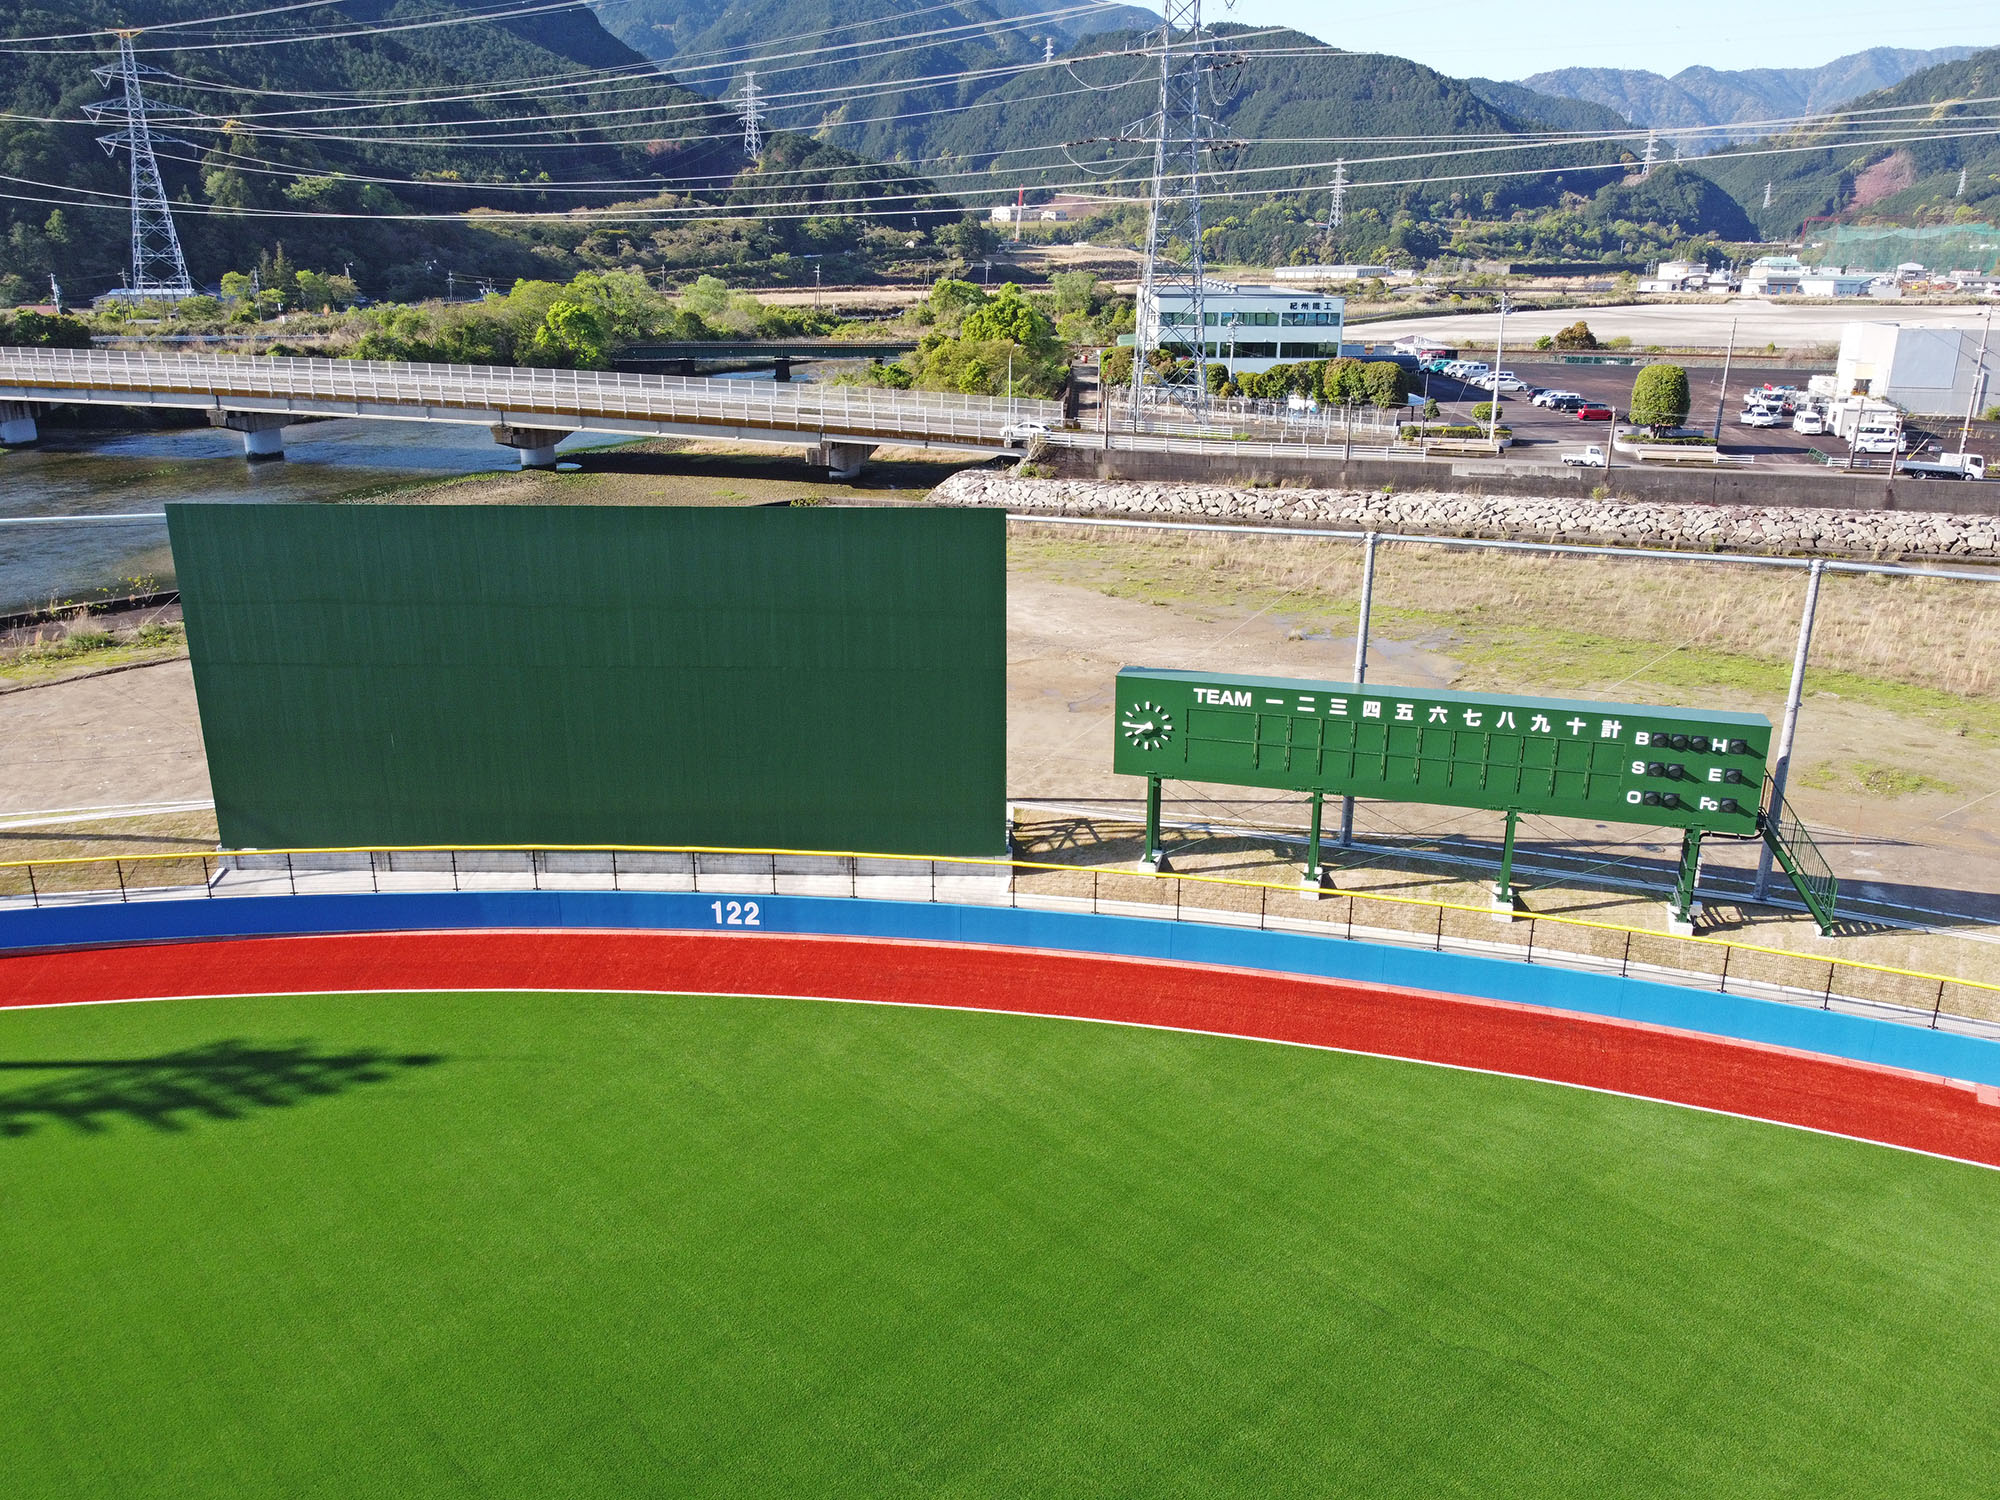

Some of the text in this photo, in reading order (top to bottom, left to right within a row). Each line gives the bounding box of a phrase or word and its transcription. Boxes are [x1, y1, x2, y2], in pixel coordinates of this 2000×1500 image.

[1193, 688, 1252, 707] TEAM
[1297, 697, 1316, 713] 二
[1329, 699, 1348, 716] 三
[1363, 701, 1382, 719] 四
[1395, 704, 1414, 721] 五
[1429, 706, 1449, 724] 六
[1463, 709, 1483, 727] 七
[1496, 712, 1516, 730] 八
[1531, 714, 1551, 733] 九
[1566, 717, 1587, 736] 十
[1601, 720, 1623, 739] 計
[1635, 732, 1650, 745] B
[1712, 738, 1728, 752] H
[1632, 761, 1645, 775] S
[1708, 768, 1723, 782] E
[711, 901, 760, 925] 122
